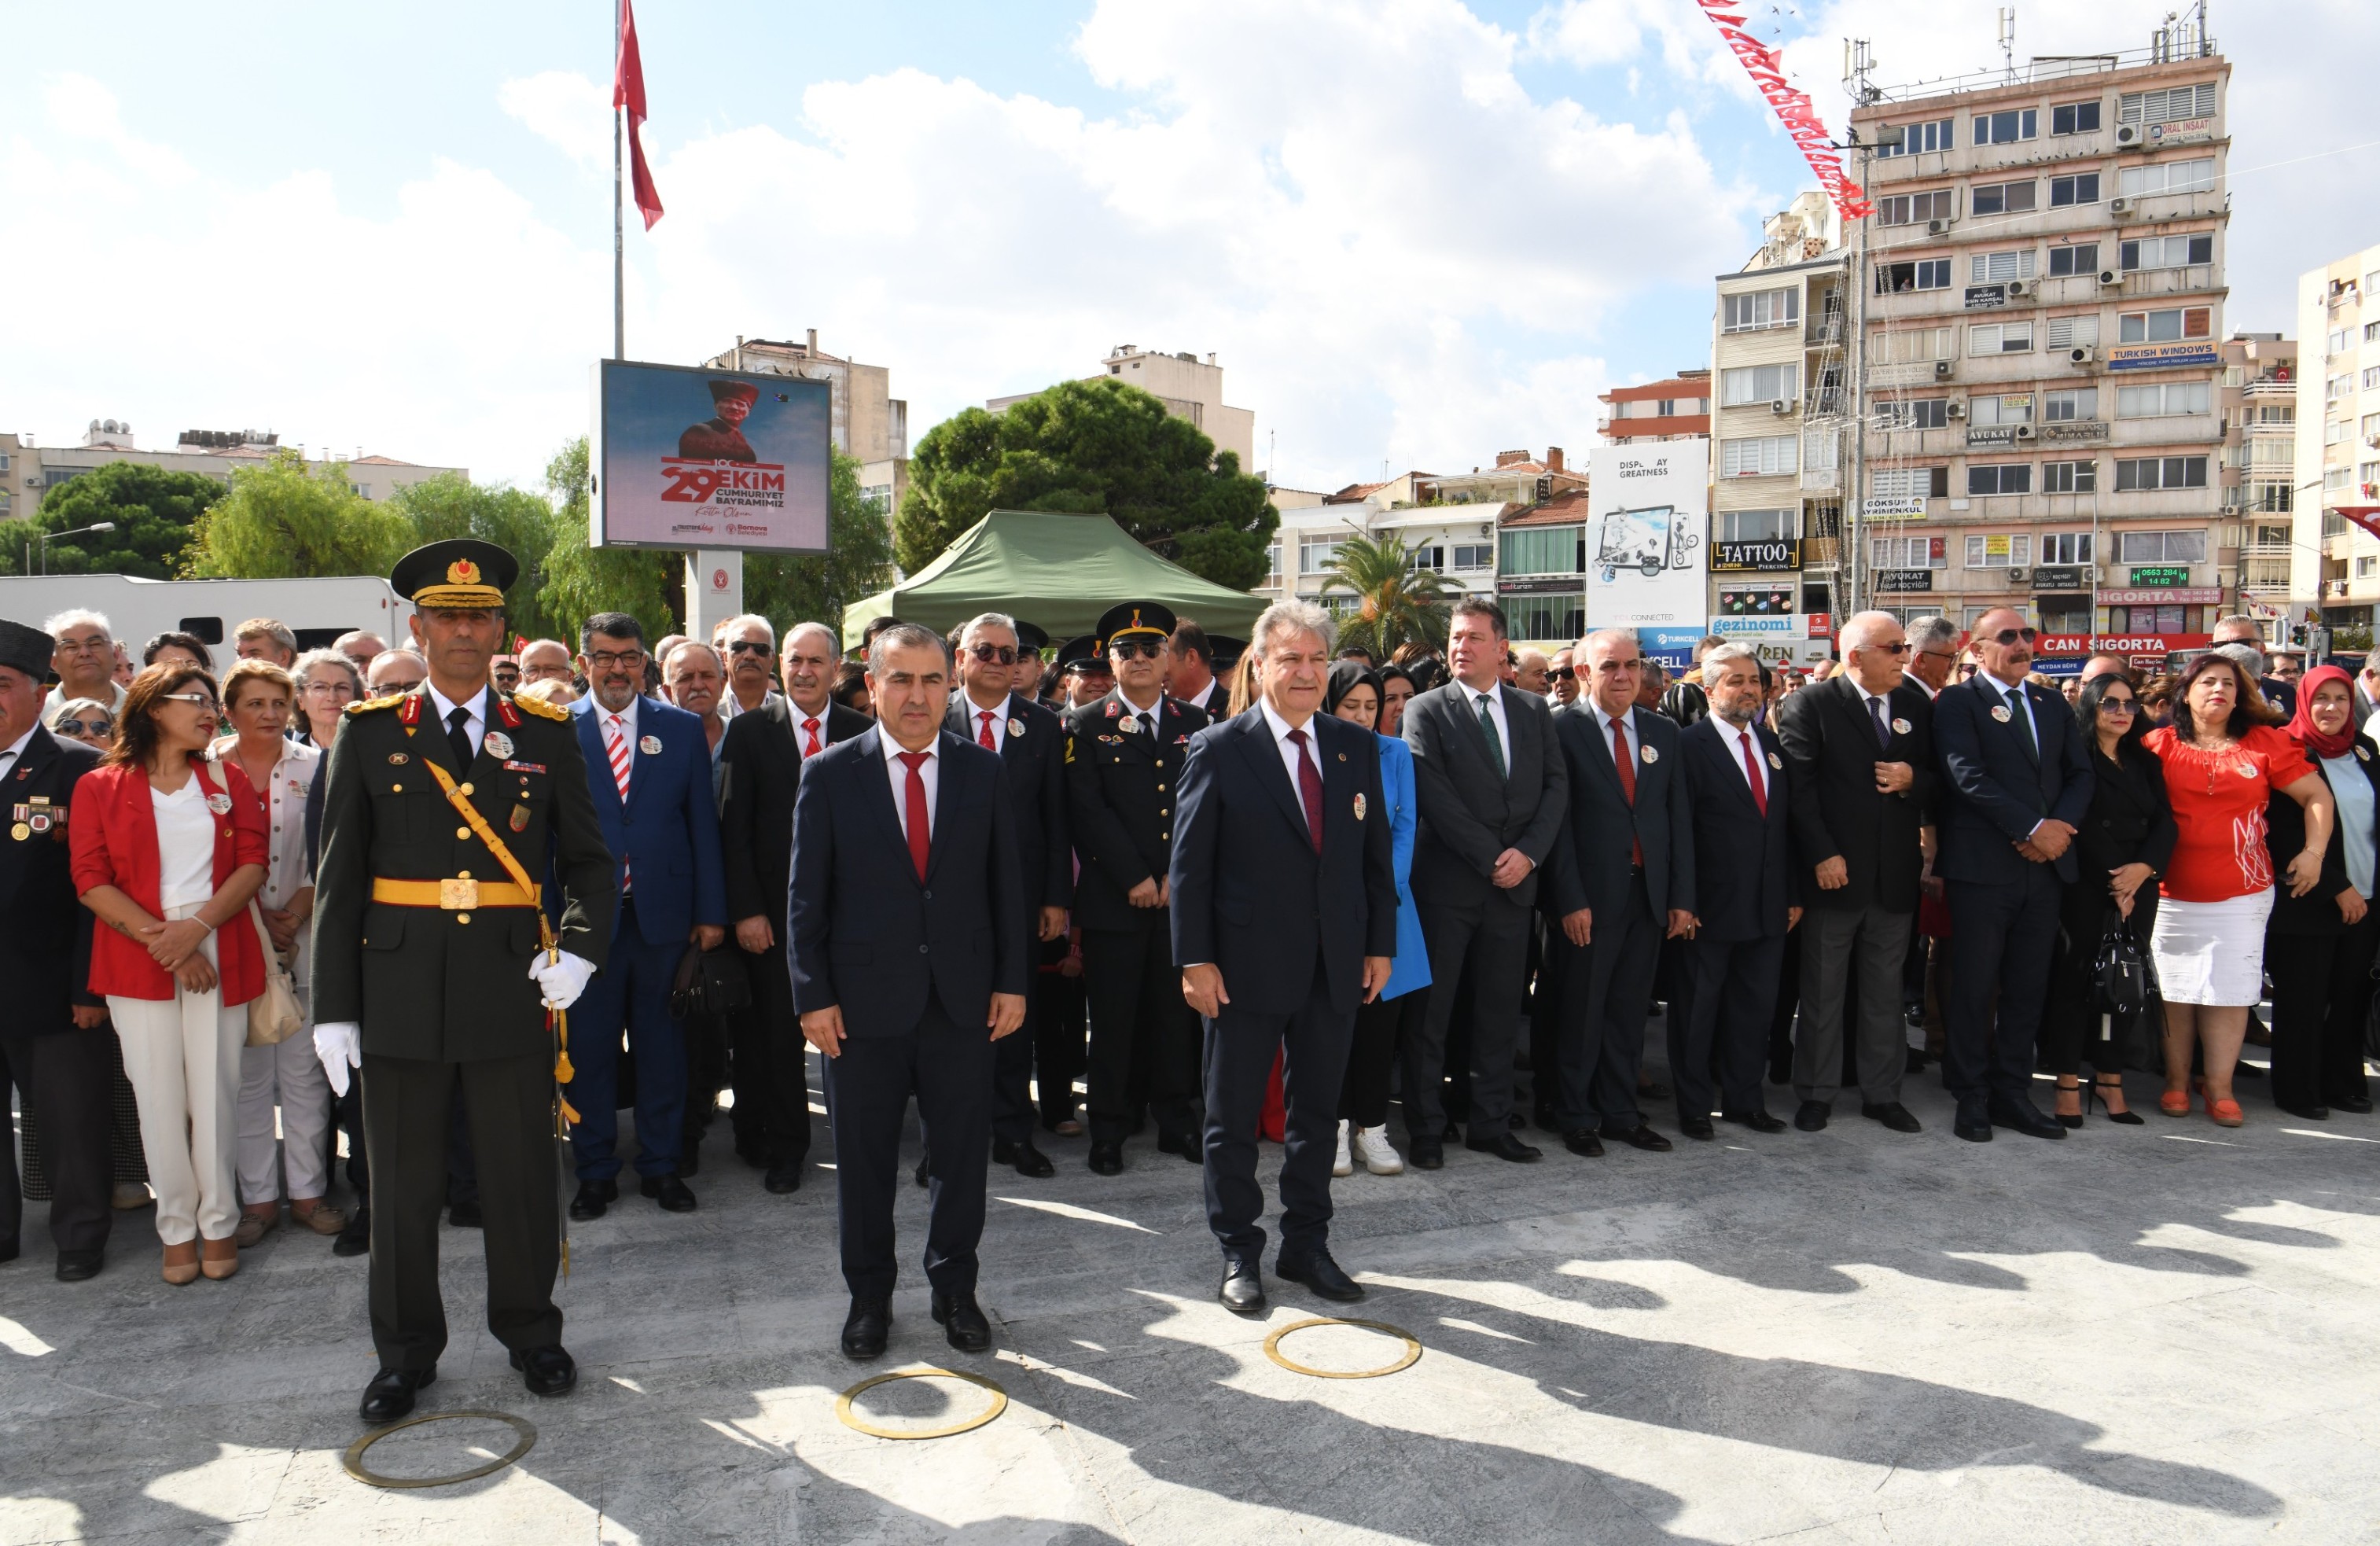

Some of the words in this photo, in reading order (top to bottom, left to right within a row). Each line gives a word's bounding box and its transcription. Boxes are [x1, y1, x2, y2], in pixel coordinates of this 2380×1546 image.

[2163, 124, 2181, 134] ORAL
[2114, 349, 2156, 359] TURKISH
[2160, 344, 2213, 355] WINDOWS
[1970, 430, 2011, 440] AVUKAT
[1620, 468, 1668, 478] GREATNESS
[661, 467, 718, 502] 29
[716, 497, 784, 507] BAYRAMIMIZ
[1723, 543, 1788, 562] TATTOO
[1713, 617, 1792, 635] gezinomi
[2044, 639, 2080, 651] CAN
